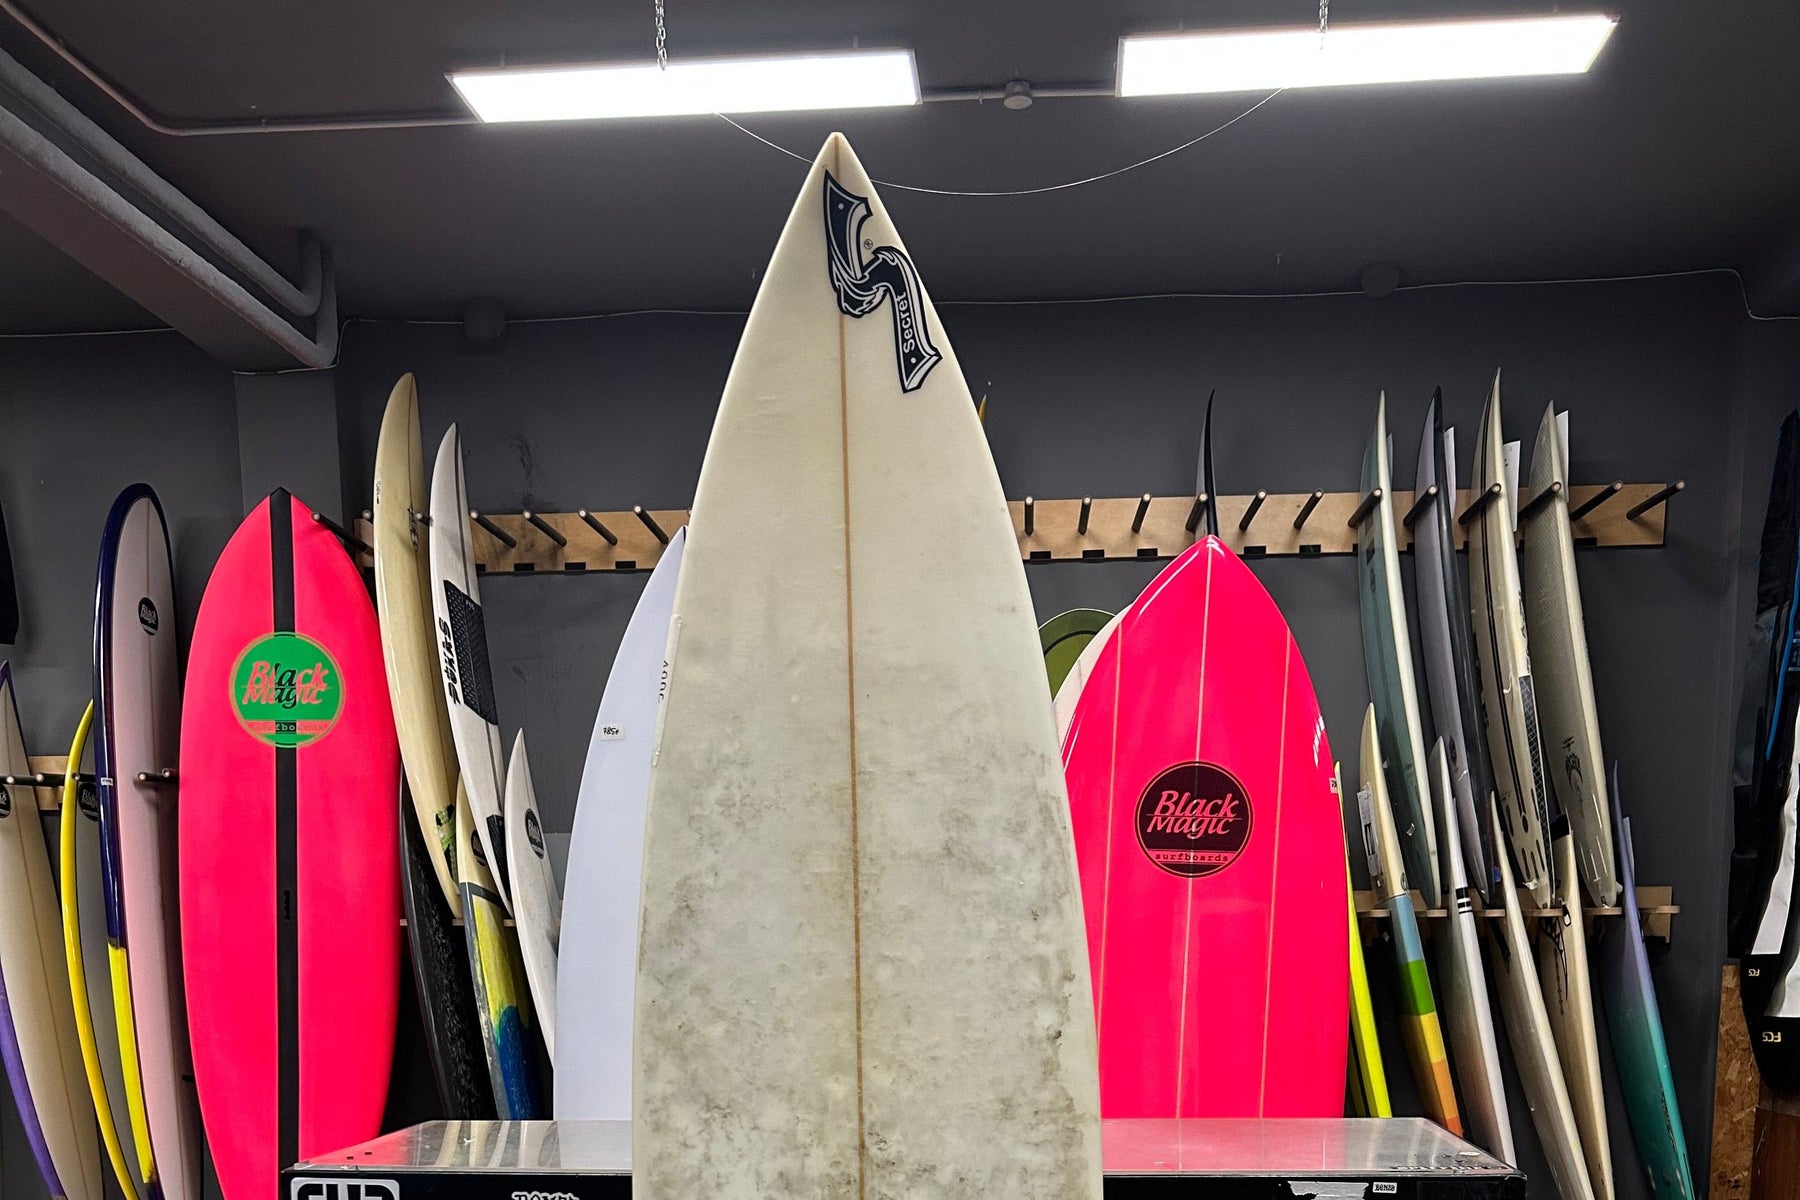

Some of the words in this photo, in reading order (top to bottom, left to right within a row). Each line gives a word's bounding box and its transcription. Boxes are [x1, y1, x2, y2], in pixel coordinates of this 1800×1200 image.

[898, 291, 916, 354] Secret
[245, 660, 330, 691] Black
[242, 685, 324, 710] Magic
[1153, 790, 1240, 818] Black
[1146, 815, 1235, 840] Magic
[1154, 852, 1230, 863] surfboards
[1748, 968, 1760, 977] FCS
[1762, 1031, 1782, 1043] FCS
